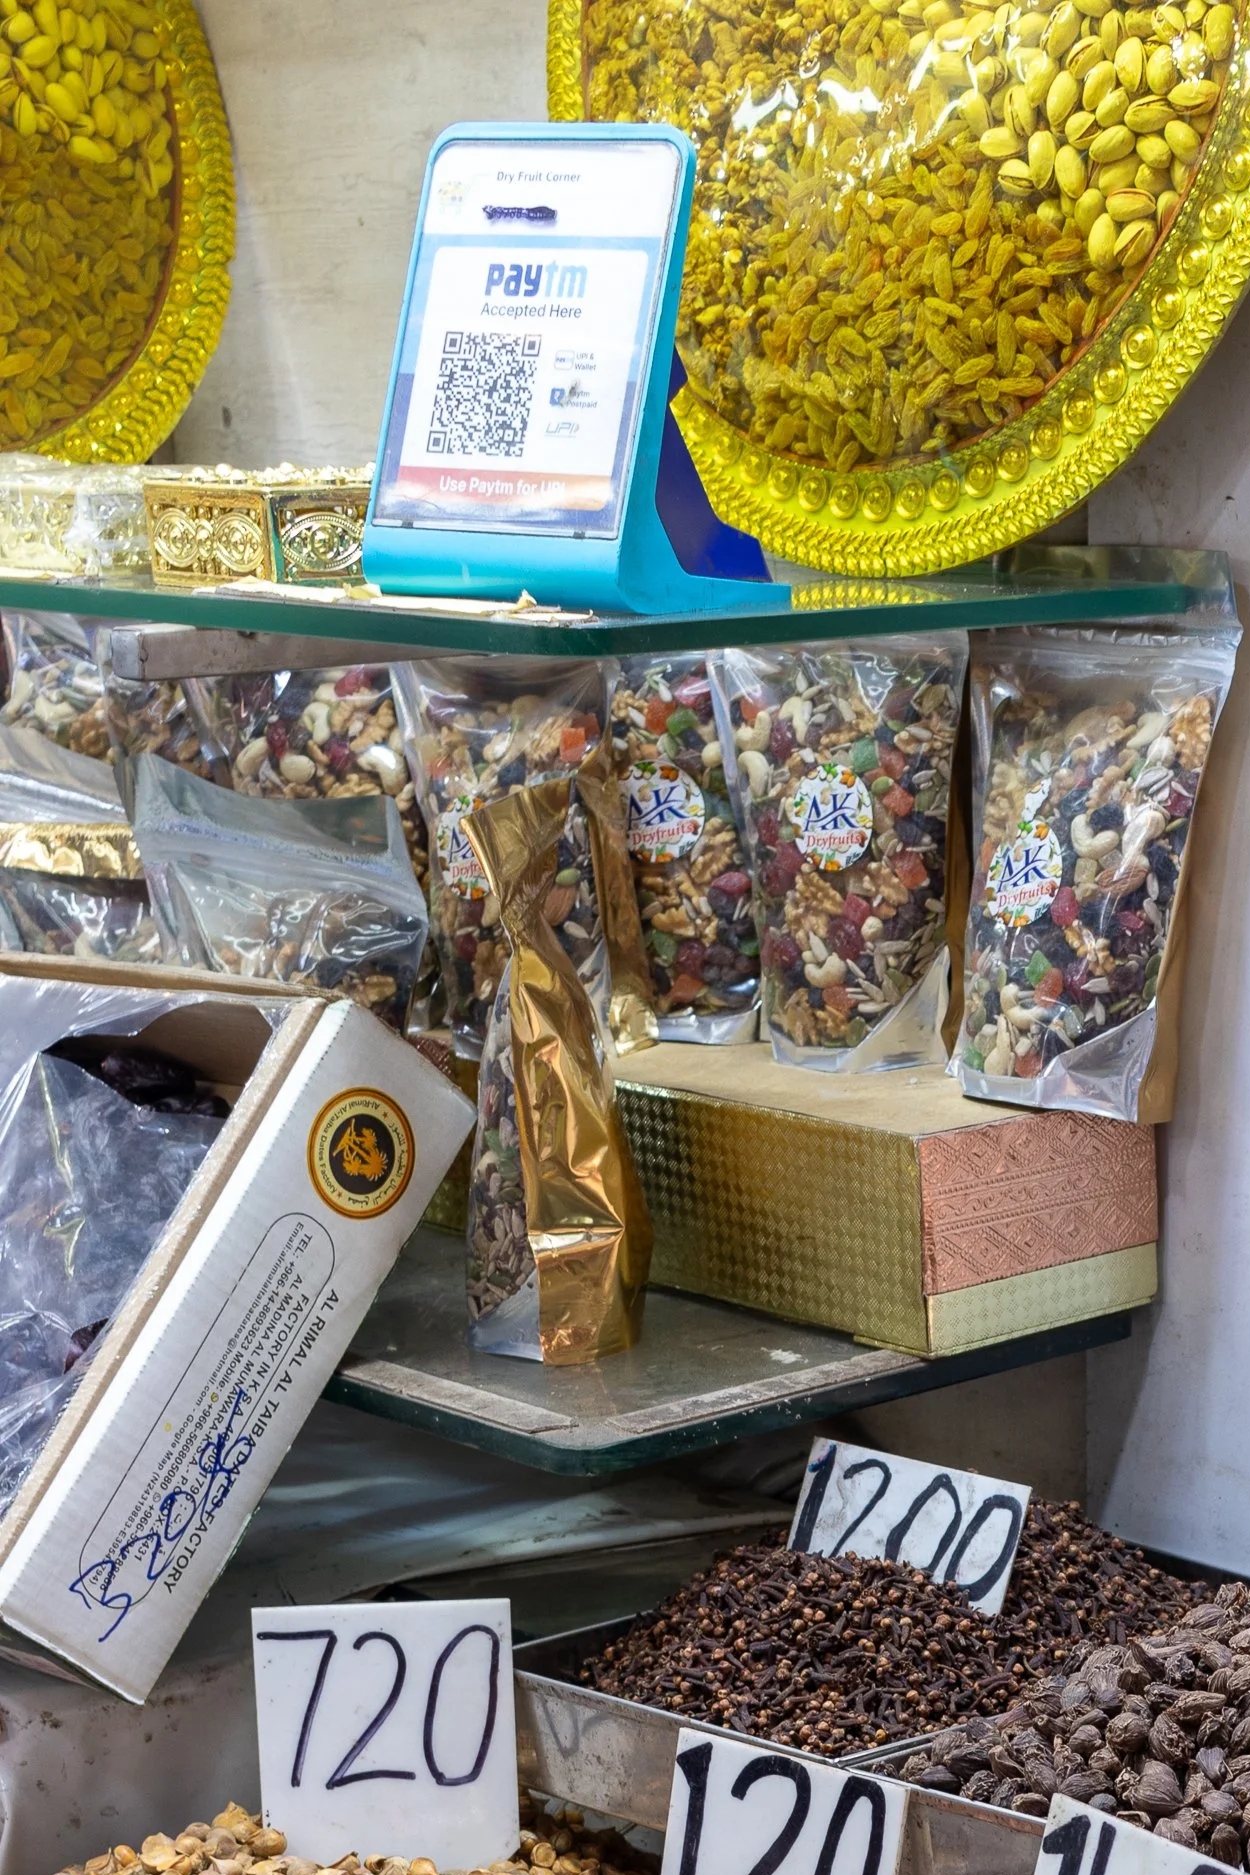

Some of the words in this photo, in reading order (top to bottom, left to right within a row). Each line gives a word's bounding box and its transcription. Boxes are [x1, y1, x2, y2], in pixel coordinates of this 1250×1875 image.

[497, 171, 514, 184] Dry
[518, 171, 543, 182] Fruit
[546, 172, 582, 182] Corner
[481, 302, 546, 320] Accepted
[549, 304, 582, 318] Here
[440, 476, 466, 492] Use
[469, 477, 513, 496] Paytm
[517, 479, 537, 495] for
[803, 791, 859, 832] AK
[632, 819, 695, 846] Dryfruits
[807, 831, 861, 849] Dryfruits
[997, 844, 1050, 893] AK
[998, 884, 1052, 908] Dryfruits
[293, 1234, 312, 1258] TEL:
[290, 1273, 302, 1289] AL
[321, 1289, 339, 1310] AL
[196, 1222, 304, 1406] Email:alrimalaltaibadates@hotmail.com
[241, 1261, 294, 1350] +966-14-8693623
[262, 1293, 293, 1340] MADINA
[268, 1294, 309, 1362] FACTORY
[289, 1315, 326, 1367] RIMAL
[251, 1341, 264, 1356] AL
[216, 1351, 244, 1392] Mobile:
[257, 1362, 270, 1379] IN
[274, 1370, 292, 1392] AL
[171, 1414, 194, 1448] Google
[244, 1400, 279, 1450] TAIBA
[158, 1450, 173, 1470] Map
[160, 1404, 212, 1490] +966-566805080
[211, 1450, 248, 1508] DATES
[791, 1444, 1022, 1601] 1200
[164, 1509, 214, 1594] FACTORY
[257, 1624, 500, 1790] 720
